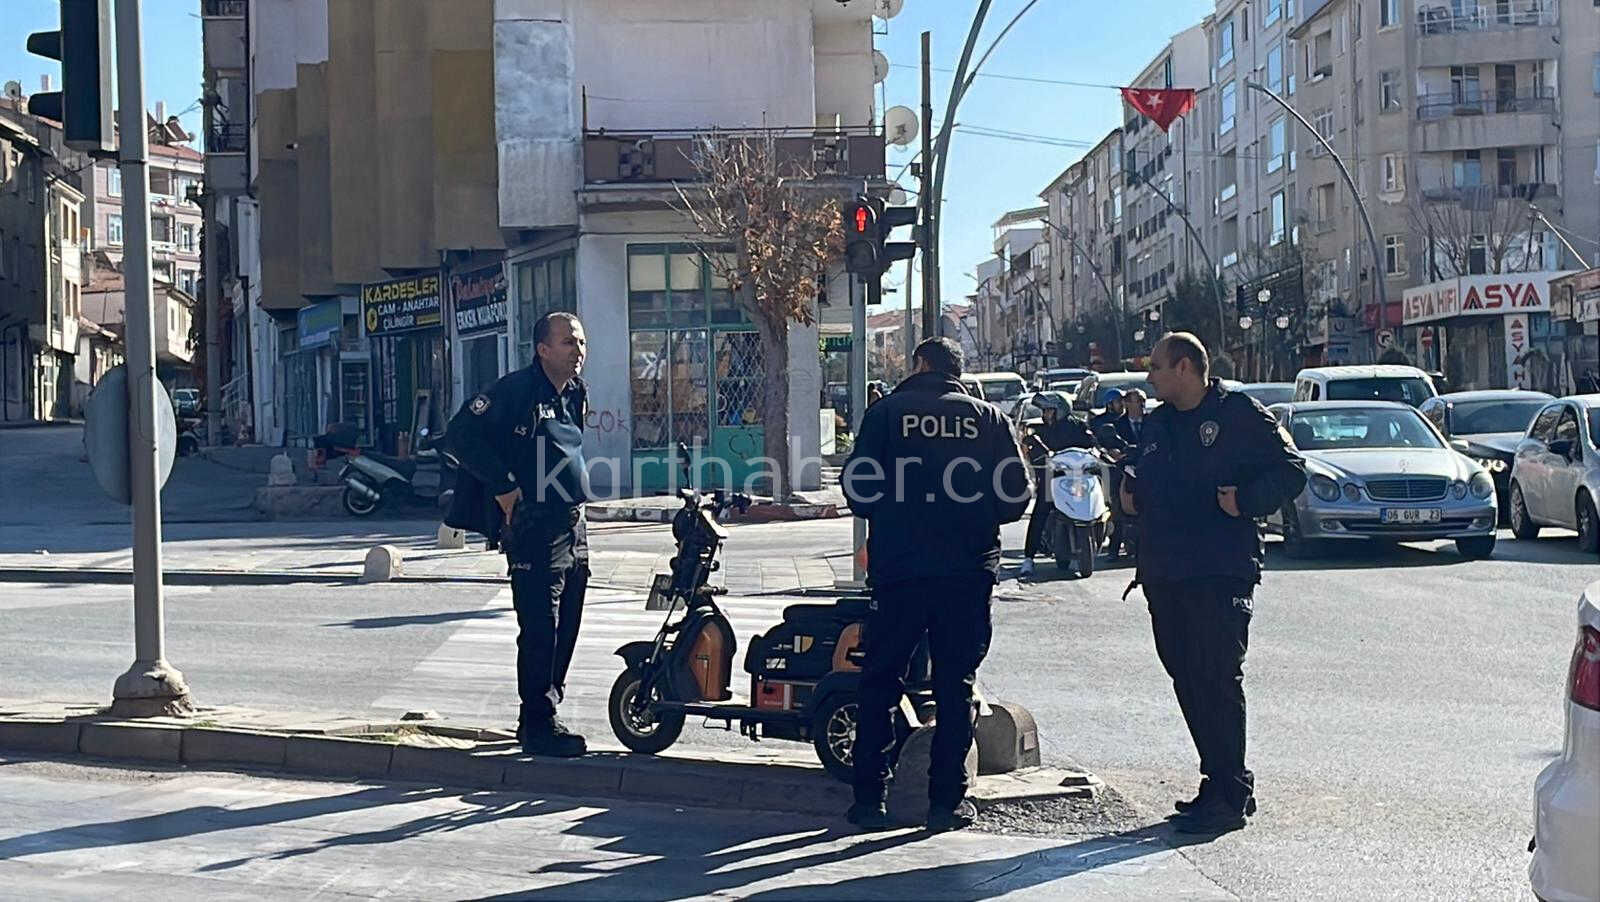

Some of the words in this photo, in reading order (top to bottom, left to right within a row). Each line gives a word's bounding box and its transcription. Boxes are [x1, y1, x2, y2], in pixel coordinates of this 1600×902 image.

[378, 303, 396, 315] CAM
[402, 296, 440, 313] ANAHTAR
[1404, 292, 1434, 321] ASYA
[1462, 282, 1542, 310] ASYA
